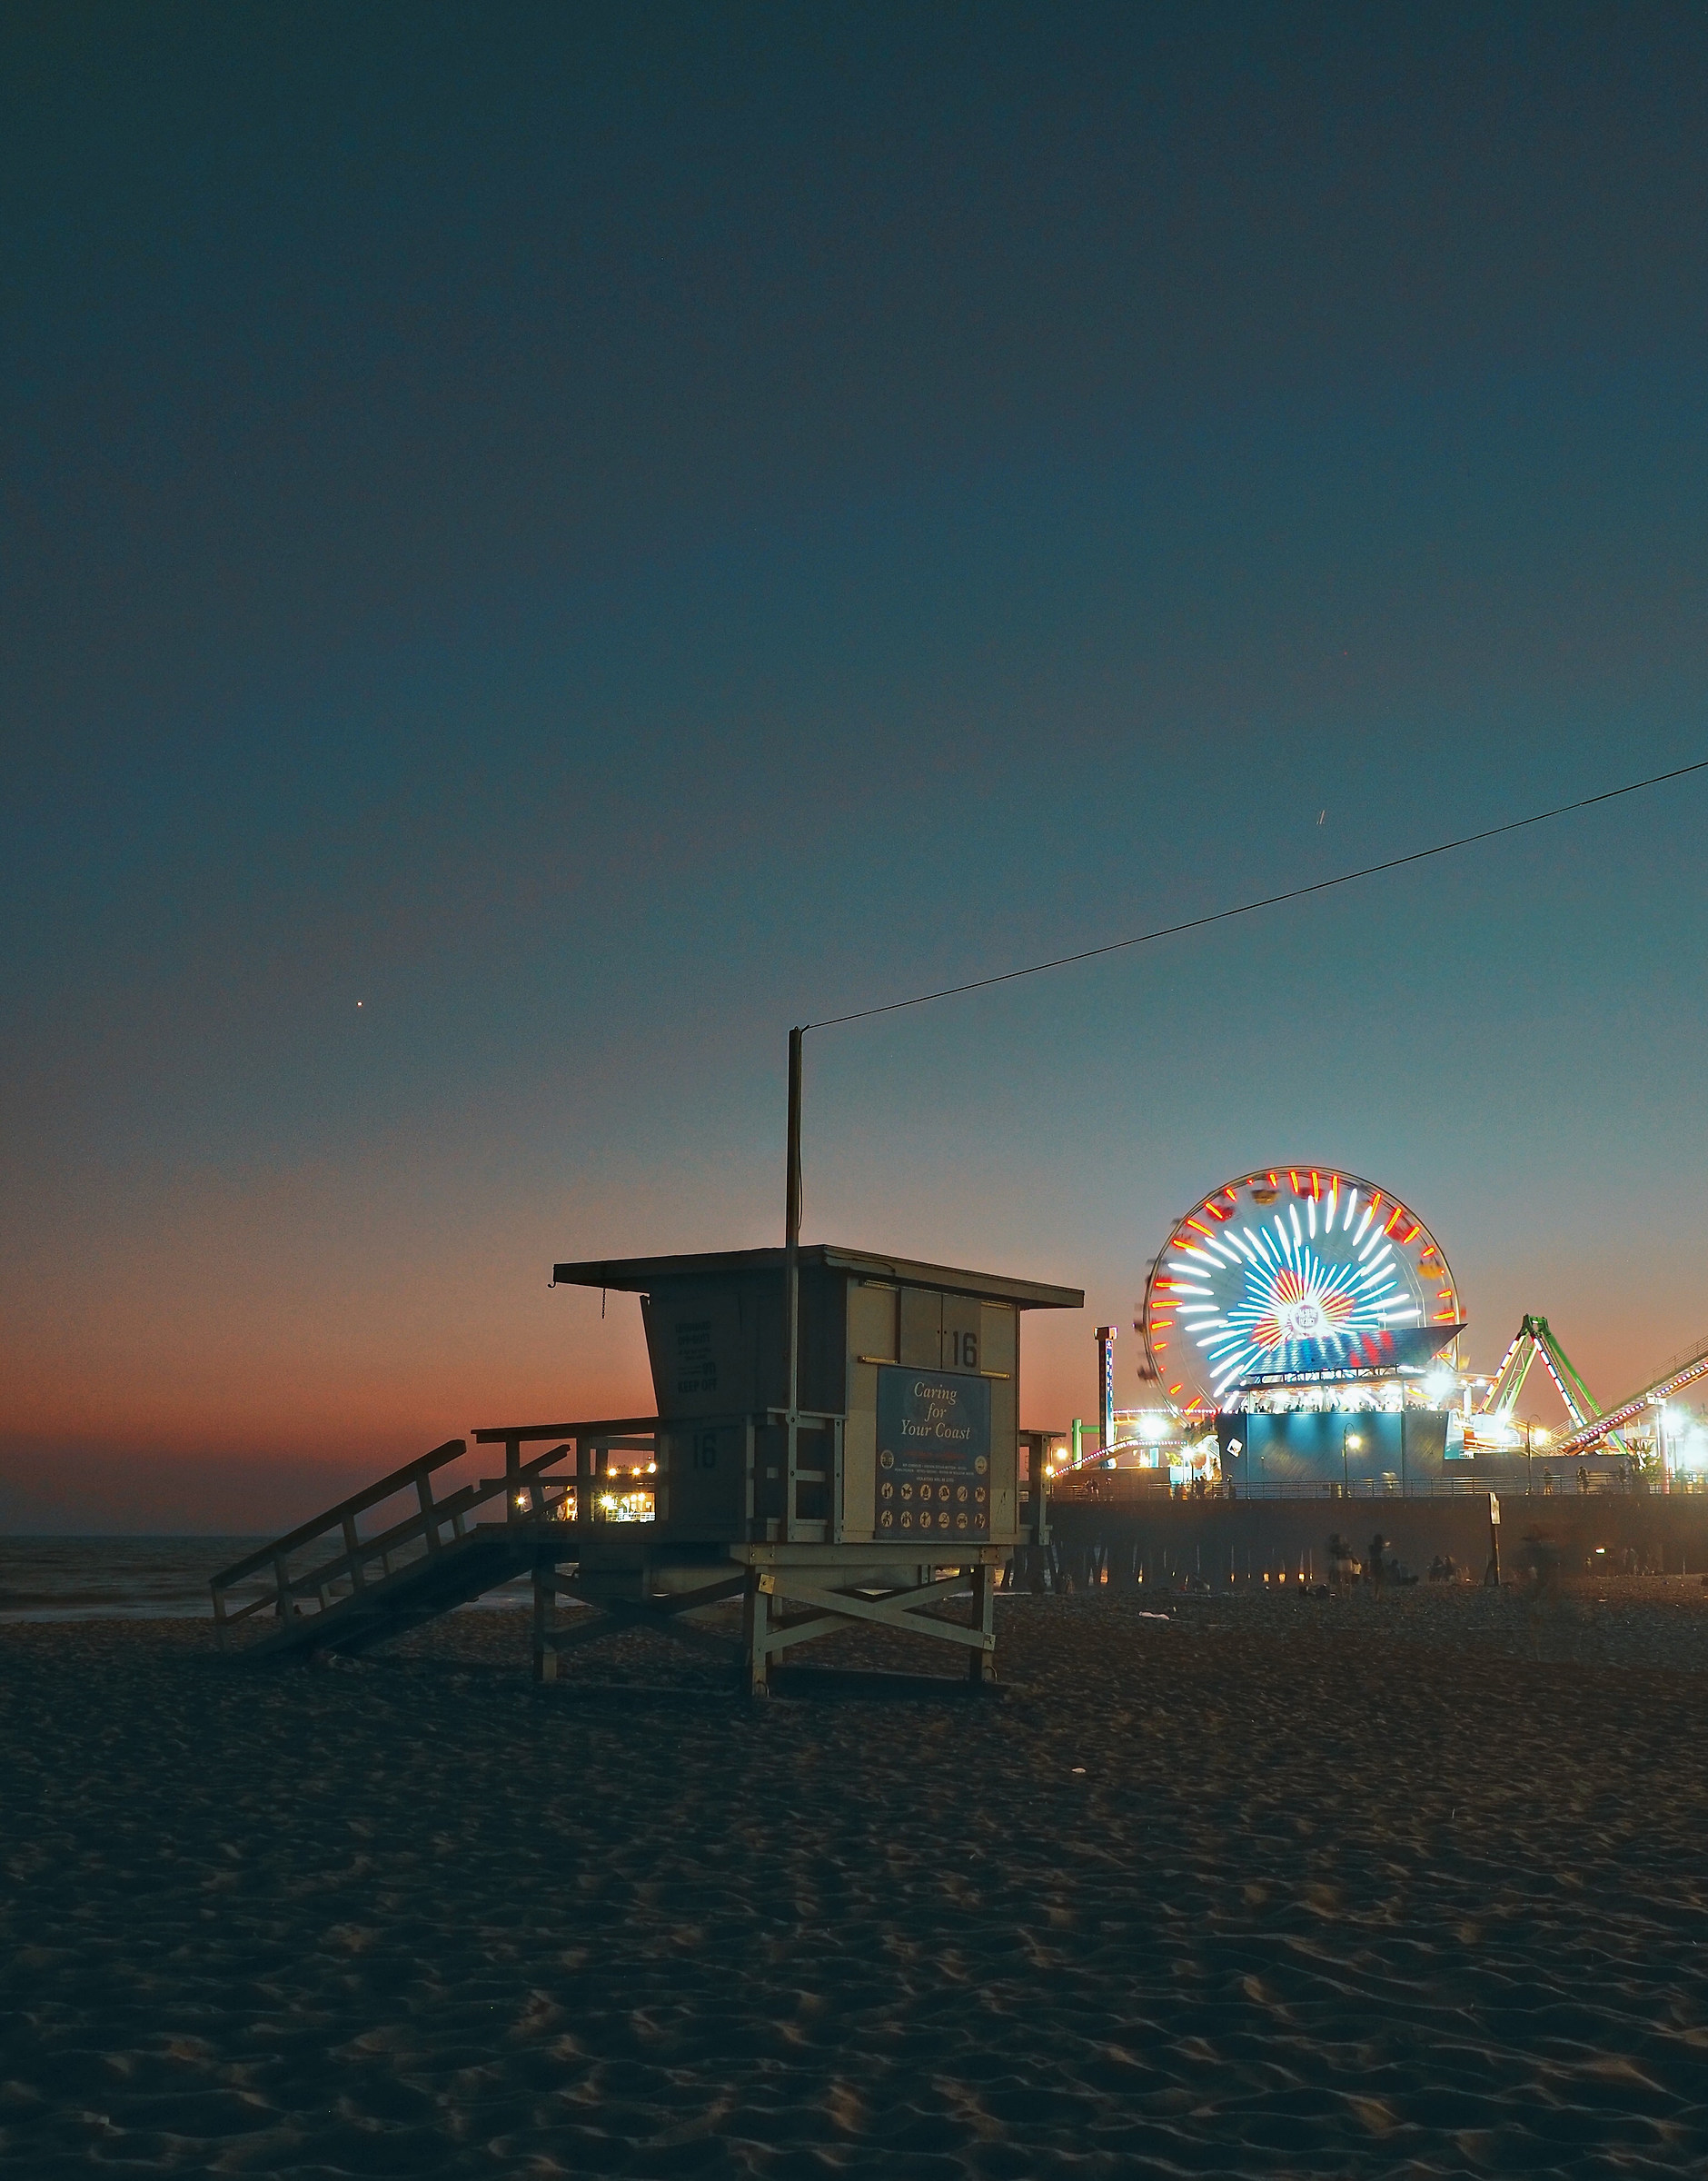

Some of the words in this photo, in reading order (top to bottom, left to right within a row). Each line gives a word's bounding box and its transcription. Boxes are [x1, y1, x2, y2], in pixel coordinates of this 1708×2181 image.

[953, 1330, 977, 1368] 16
[678, 1379, 700, 1393] KEEP
[701, 1378, 718, 1391] OFF
[914, 1381, 958, 1406] Caring
[924, 1402, 947, 1422] for
[901, 1419, 932, 1437] Your
[935, 1422, 970, 1439] Coast
[693, 1432, 716, 1469] 16
